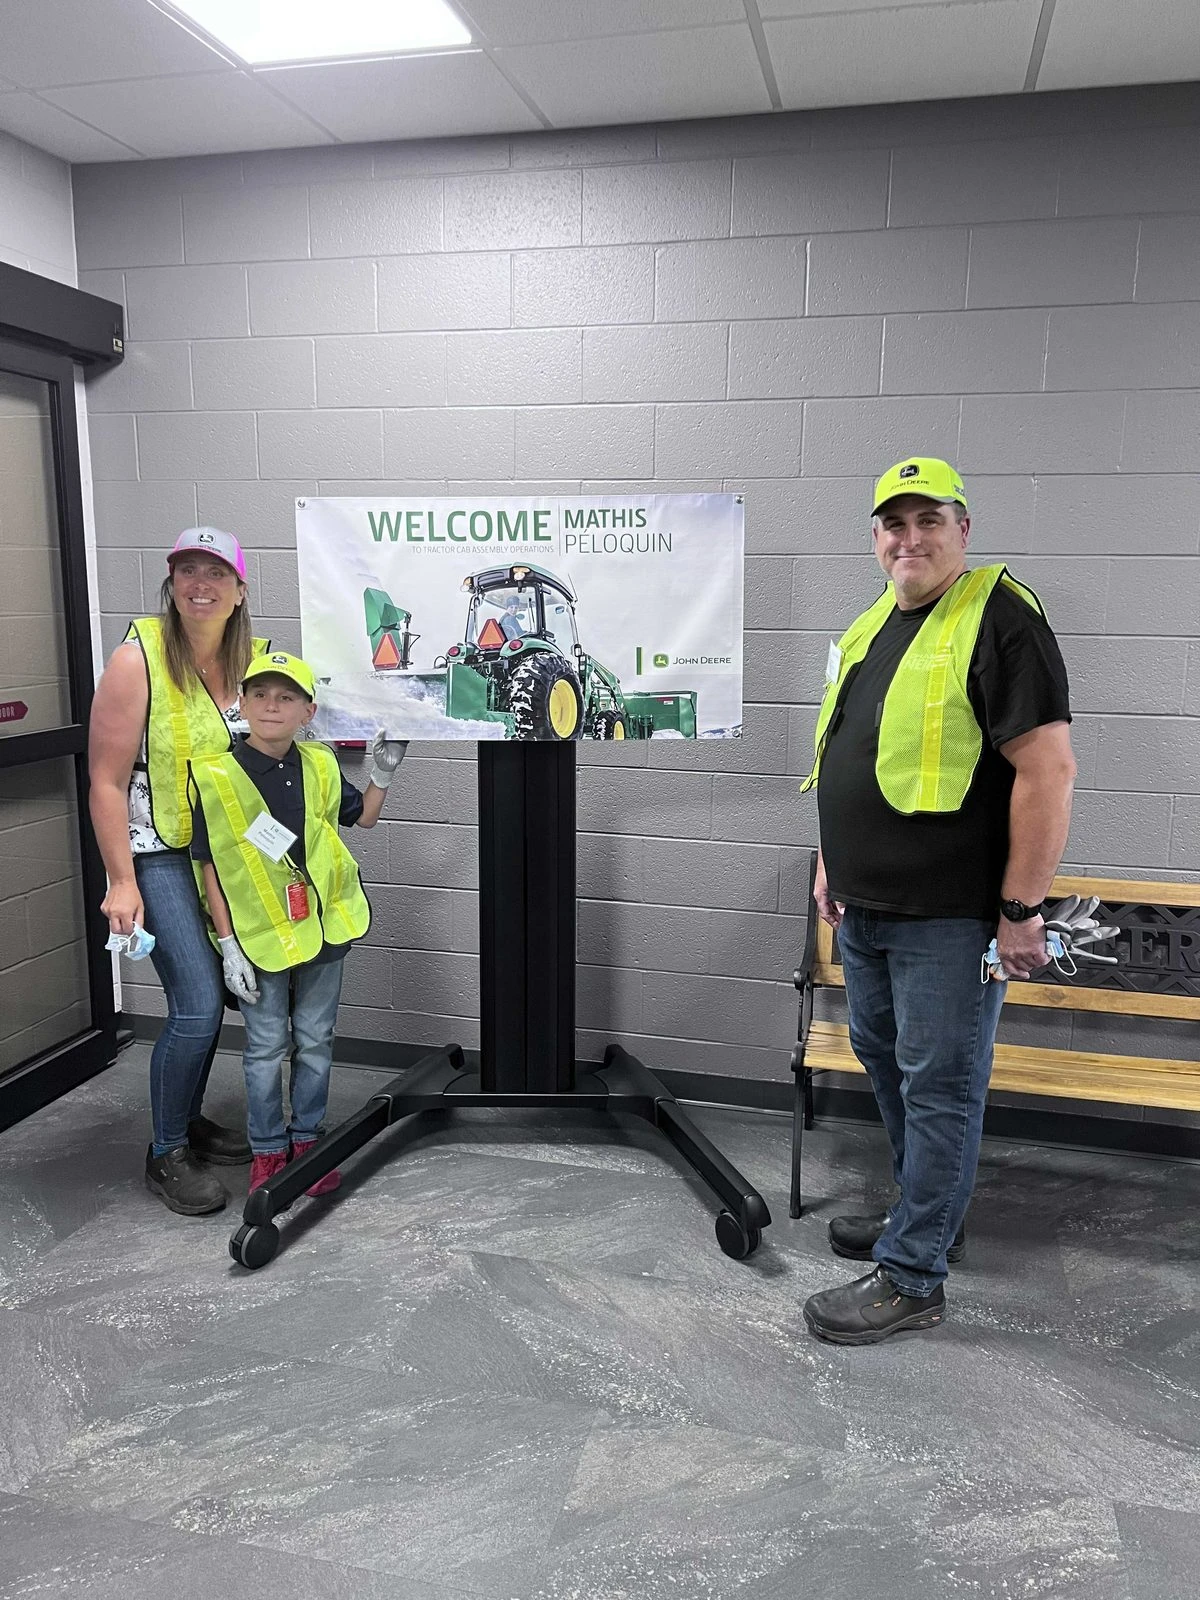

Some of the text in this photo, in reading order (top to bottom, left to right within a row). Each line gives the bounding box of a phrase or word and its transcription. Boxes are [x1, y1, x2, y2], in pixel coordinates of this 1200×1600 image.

[367, 510, 552, 542] WELCOME
[564, 508, 648, 529] MATHIS
[412, 545, 554, 554] TO TRACTOR CAB ASSEMBLY OPERATIONS
[565, 529, 672, 554] PÉLOQUIN
[673, 656, 732, 665] JOHN DEERE
